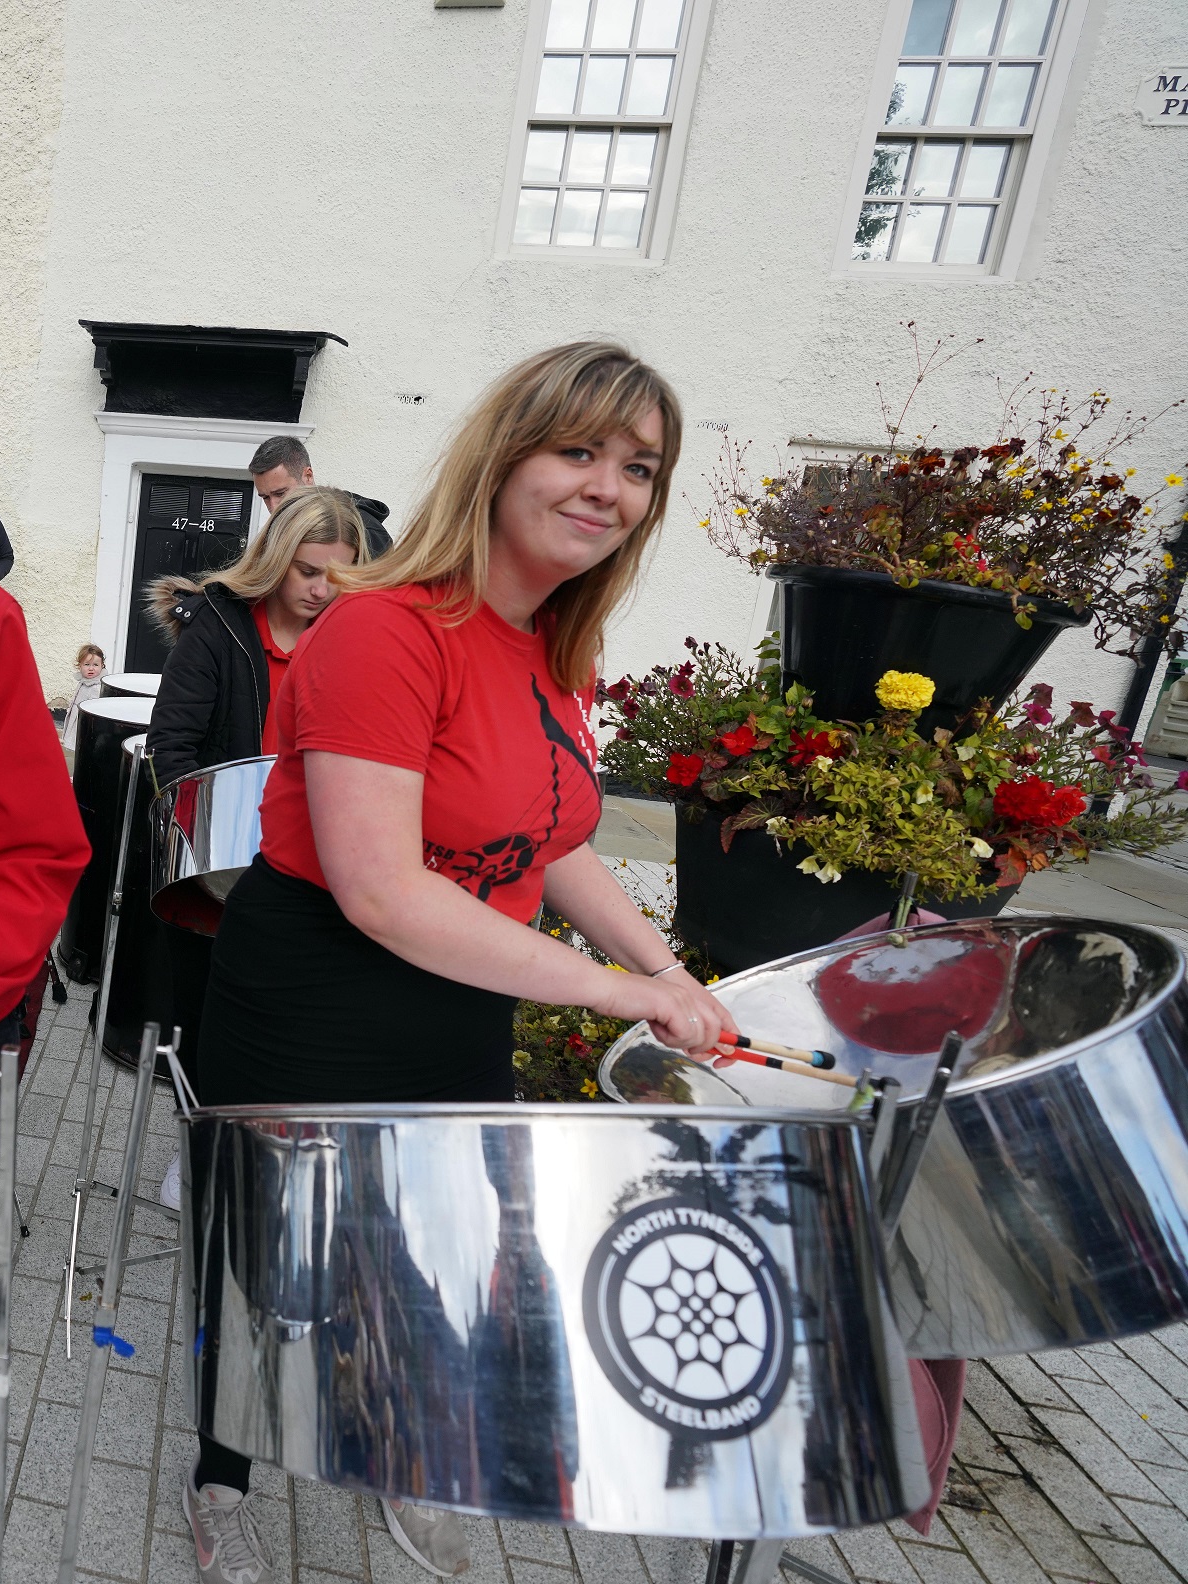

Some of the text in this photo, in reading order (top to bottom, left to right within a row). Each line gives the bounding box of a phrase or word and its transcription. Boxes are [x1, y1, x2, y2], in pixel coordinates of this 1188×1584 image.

[171, 517, 215, 532] 47-48
[611, 1207, 765, 1267] NORTH TYNESIDE
[638, 1384, 762, 1431] STEELBAND
